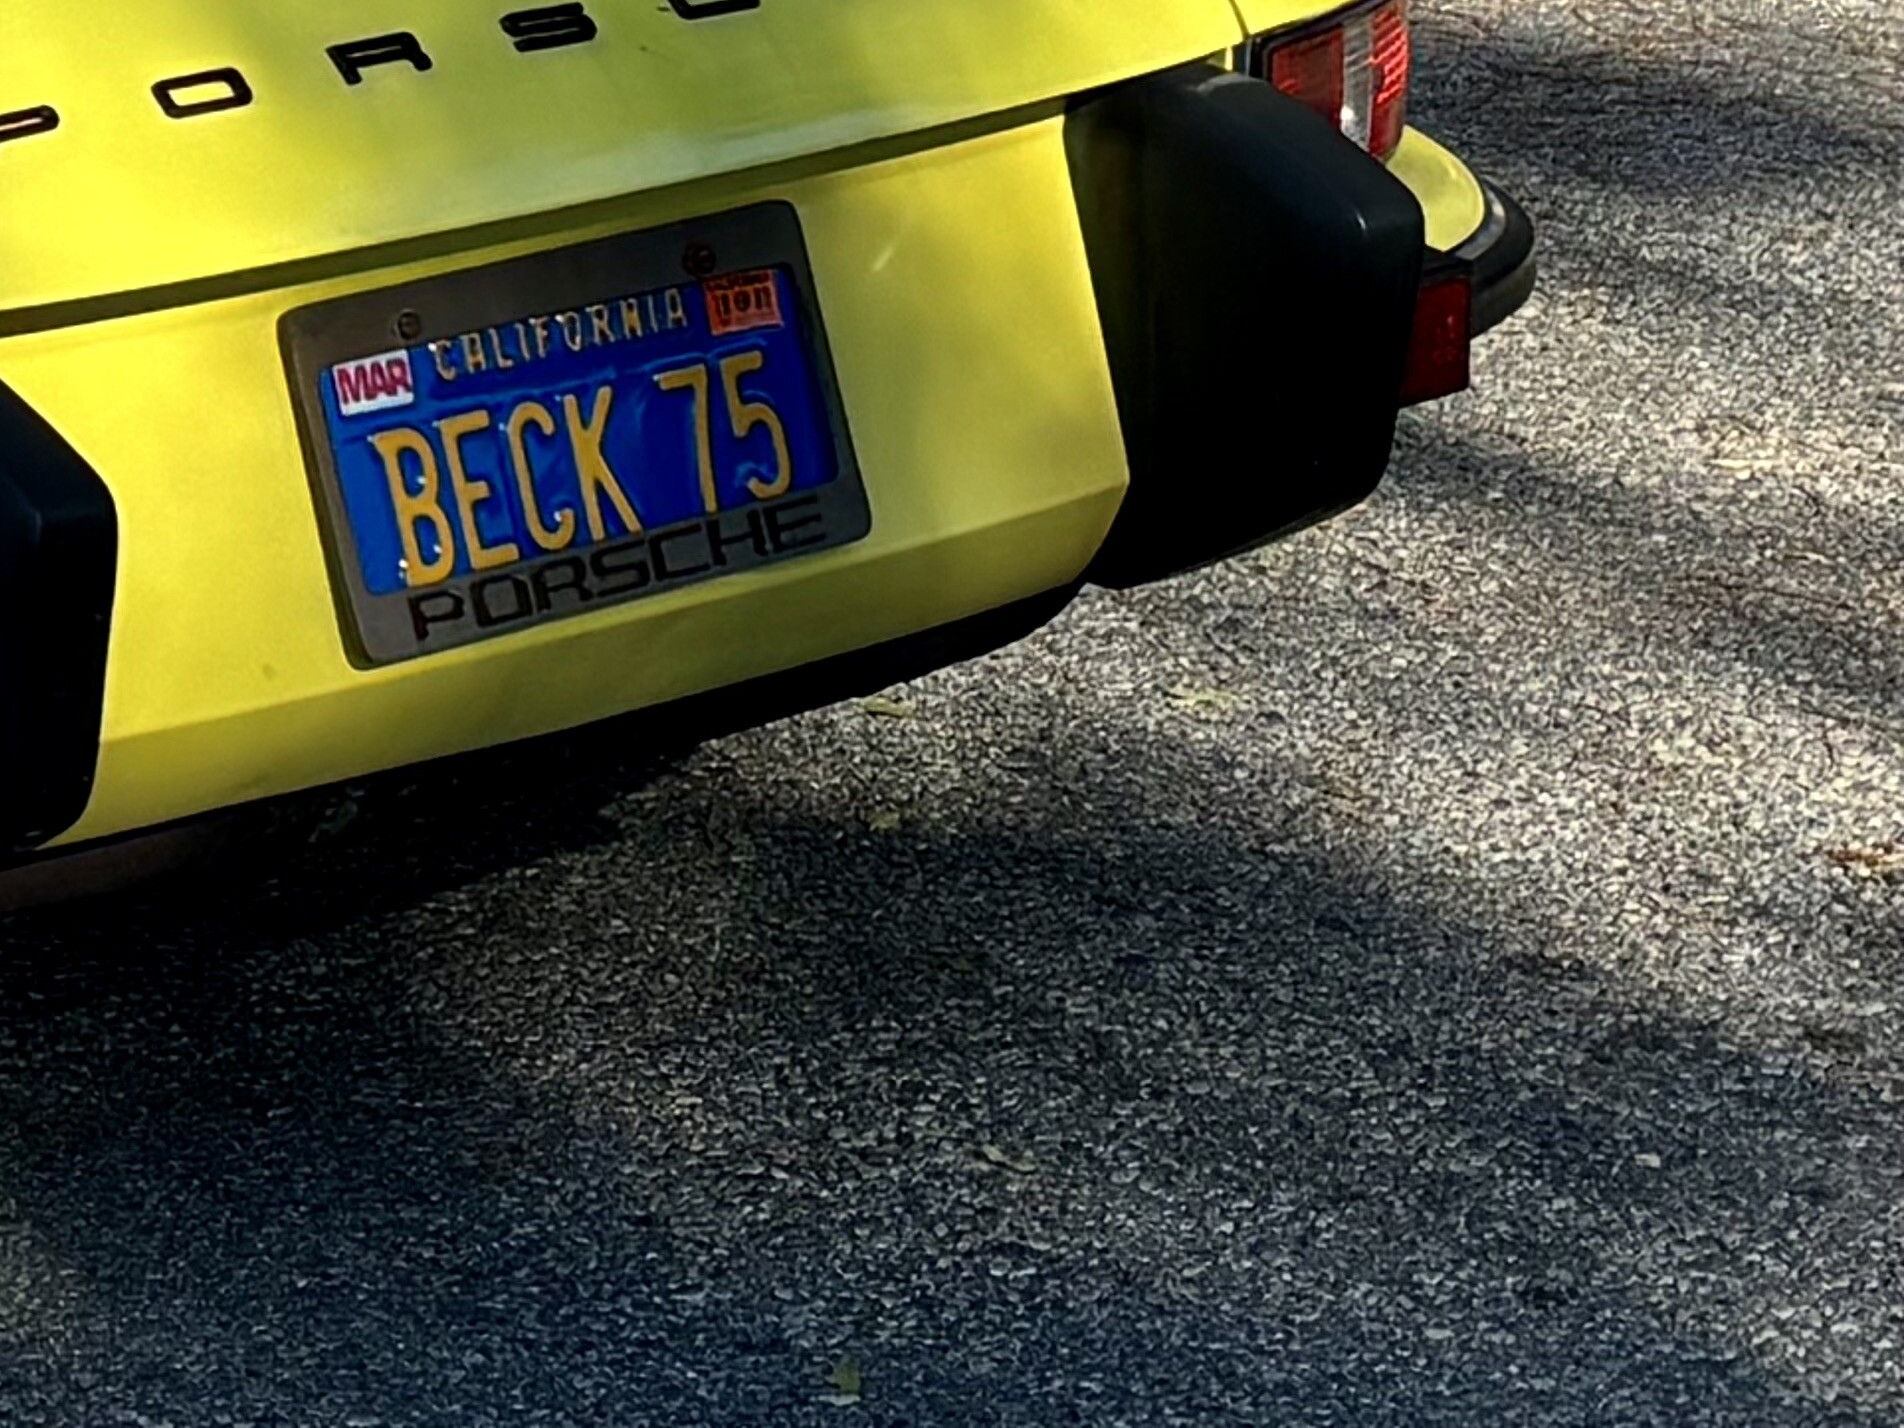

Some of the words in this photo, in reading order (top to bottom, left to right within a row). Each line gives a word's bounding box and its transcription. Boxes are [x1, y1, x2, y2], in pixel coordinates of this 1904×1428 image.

[335, 356, 412, 408] MAR
[435, 286, 689, 381] CALIFORNIA
[369, 385, 642, 588] BECK
[655, 350, 792, 514] 75
[407, 495, 827, 642] PORSCHE
